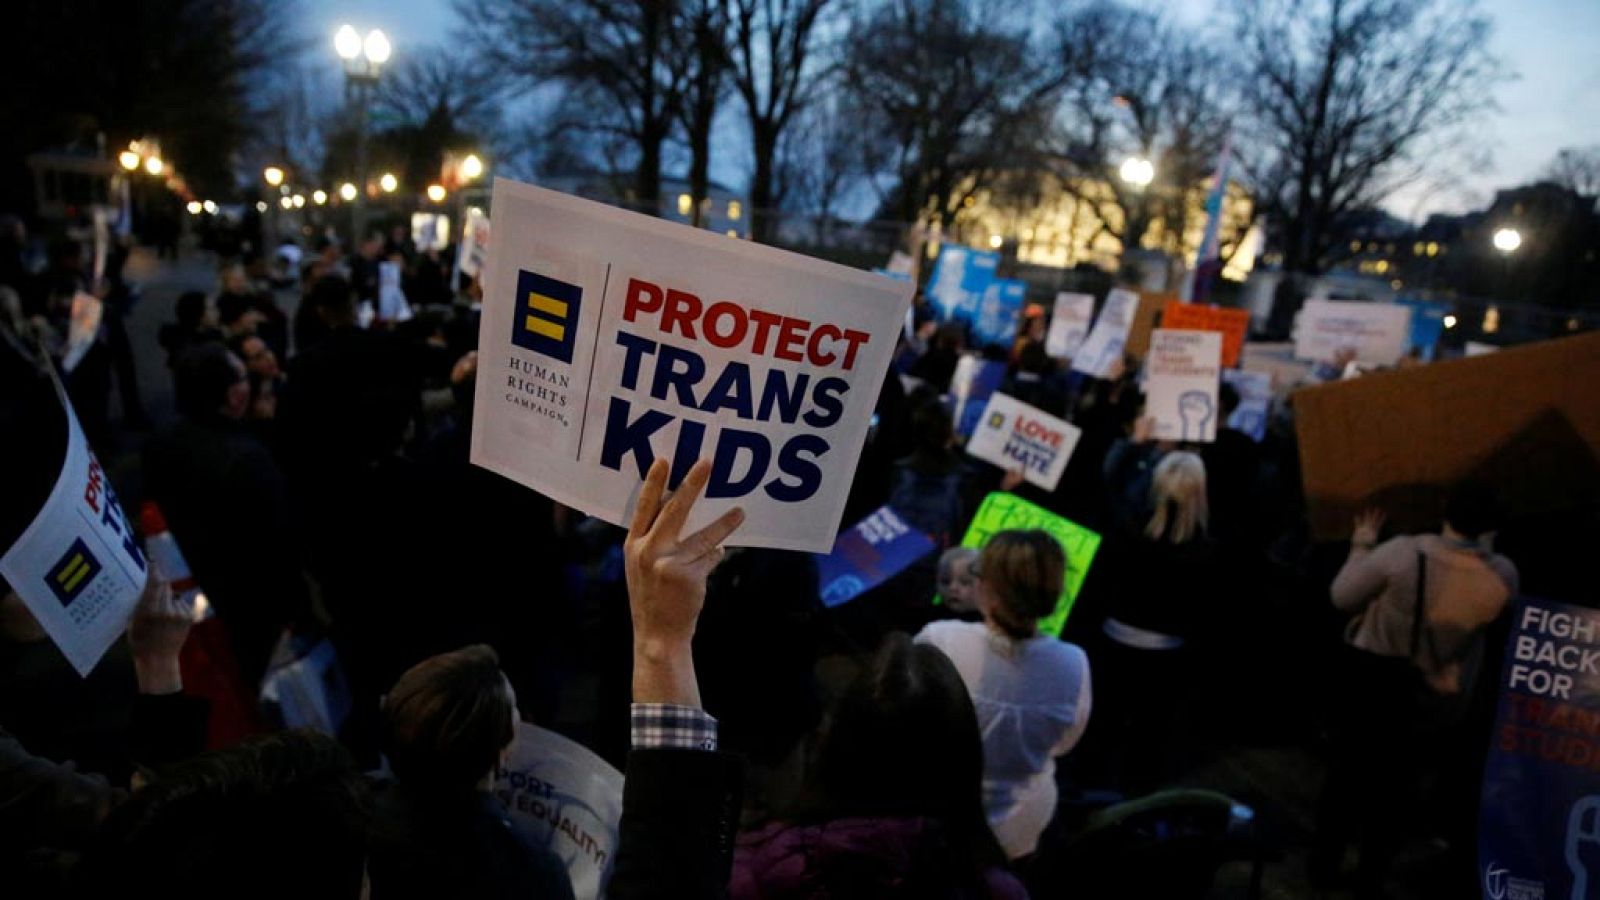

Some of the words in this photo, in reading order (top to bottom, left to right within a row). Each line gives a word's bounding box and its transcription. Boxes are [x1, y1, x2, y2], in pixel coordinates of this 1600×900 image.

[622, 277, 871, 371] PROTECT
[507, 374, 567, 407] RIGHTS
[509, 356, 570, 389] HUMAN
[615, 330, 851, 429] TRANS
[600, 396, 831, 503] KIDS
[1013, 412, 1065, 449] LOVE
[1514, 635, 1600, 676] BACK
[1509, 663, 1574, 700] FOR
